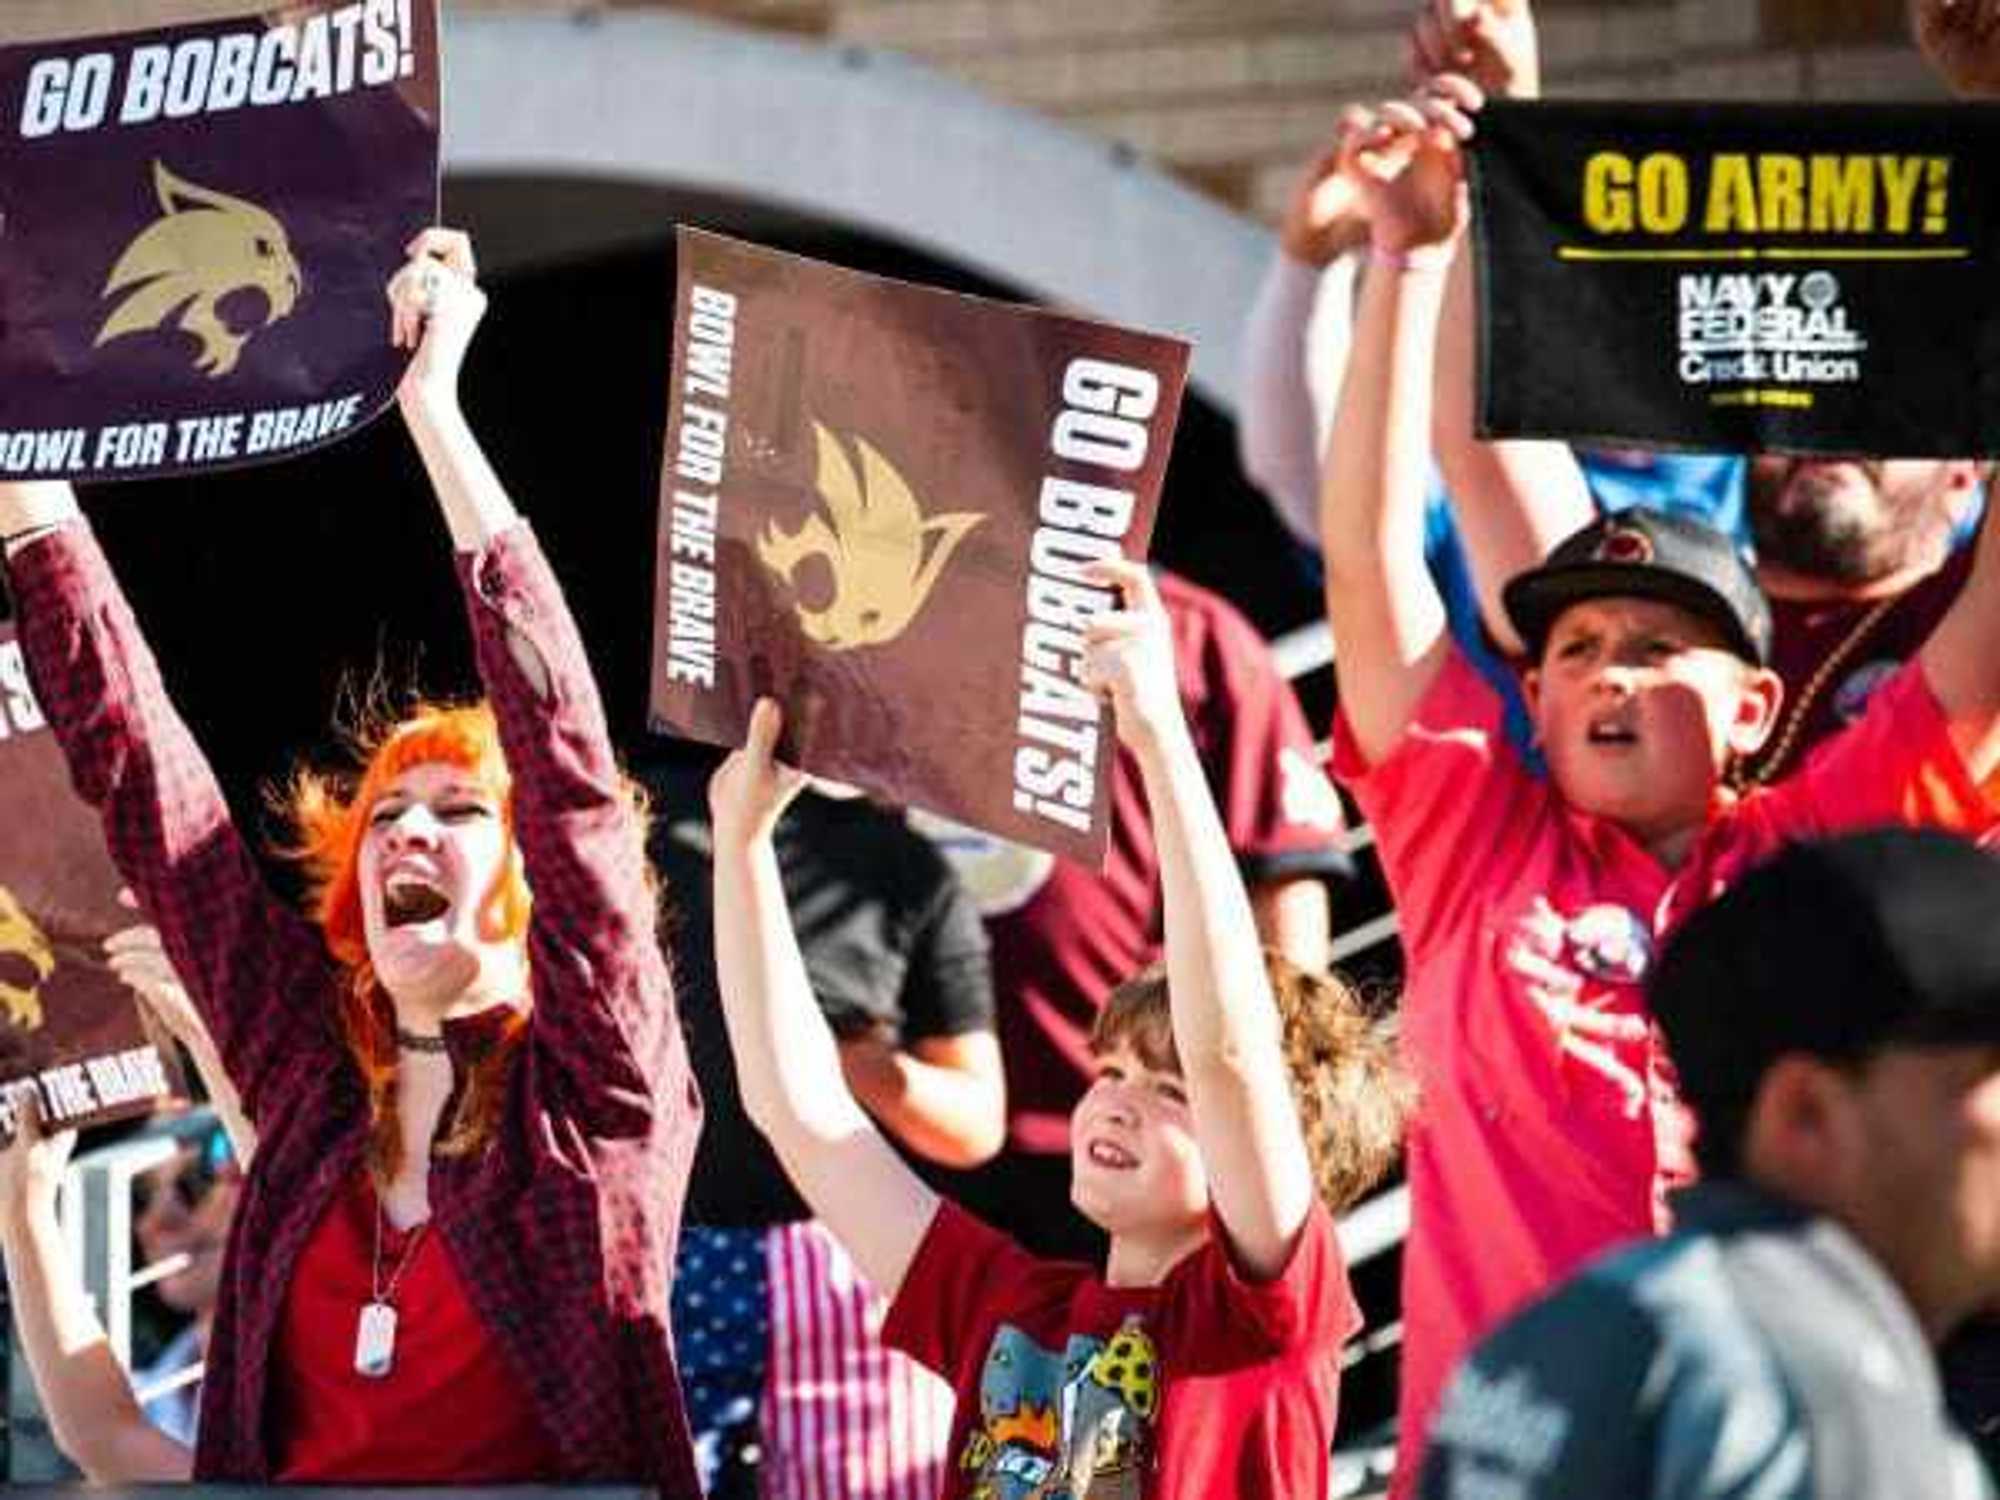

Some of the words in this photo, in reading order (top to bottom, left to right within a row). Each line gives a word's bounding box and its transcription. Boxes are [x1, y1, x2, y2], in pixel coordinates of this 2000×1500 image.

[20, 53, 115, 138] GO
[120, 0, 415, 123] BOBCATS!
[1583, 151, 1690, 234] GO
[1705, 153, 1953, 234] ARMY!
[1679, 272, 1797, 308] NAVY
[1679, 305, 1858, 340] FEDERAL
[683, 284, 738, 400] BOWL
[1773, 352, 1861, 381] Union
[95, 419, 169, 469] FOR
[174, 413, 245, 462] THE
[246, 393, 365, 452] BRAVE
[677, 403, 728, 485] FOR
[1051, 357, 1159, 471] GO
[670, 491, 719, 566] THE
[667, 560, 716, 688] BRAVE
[1013, 475, 1135, 833] BOBCATS!
